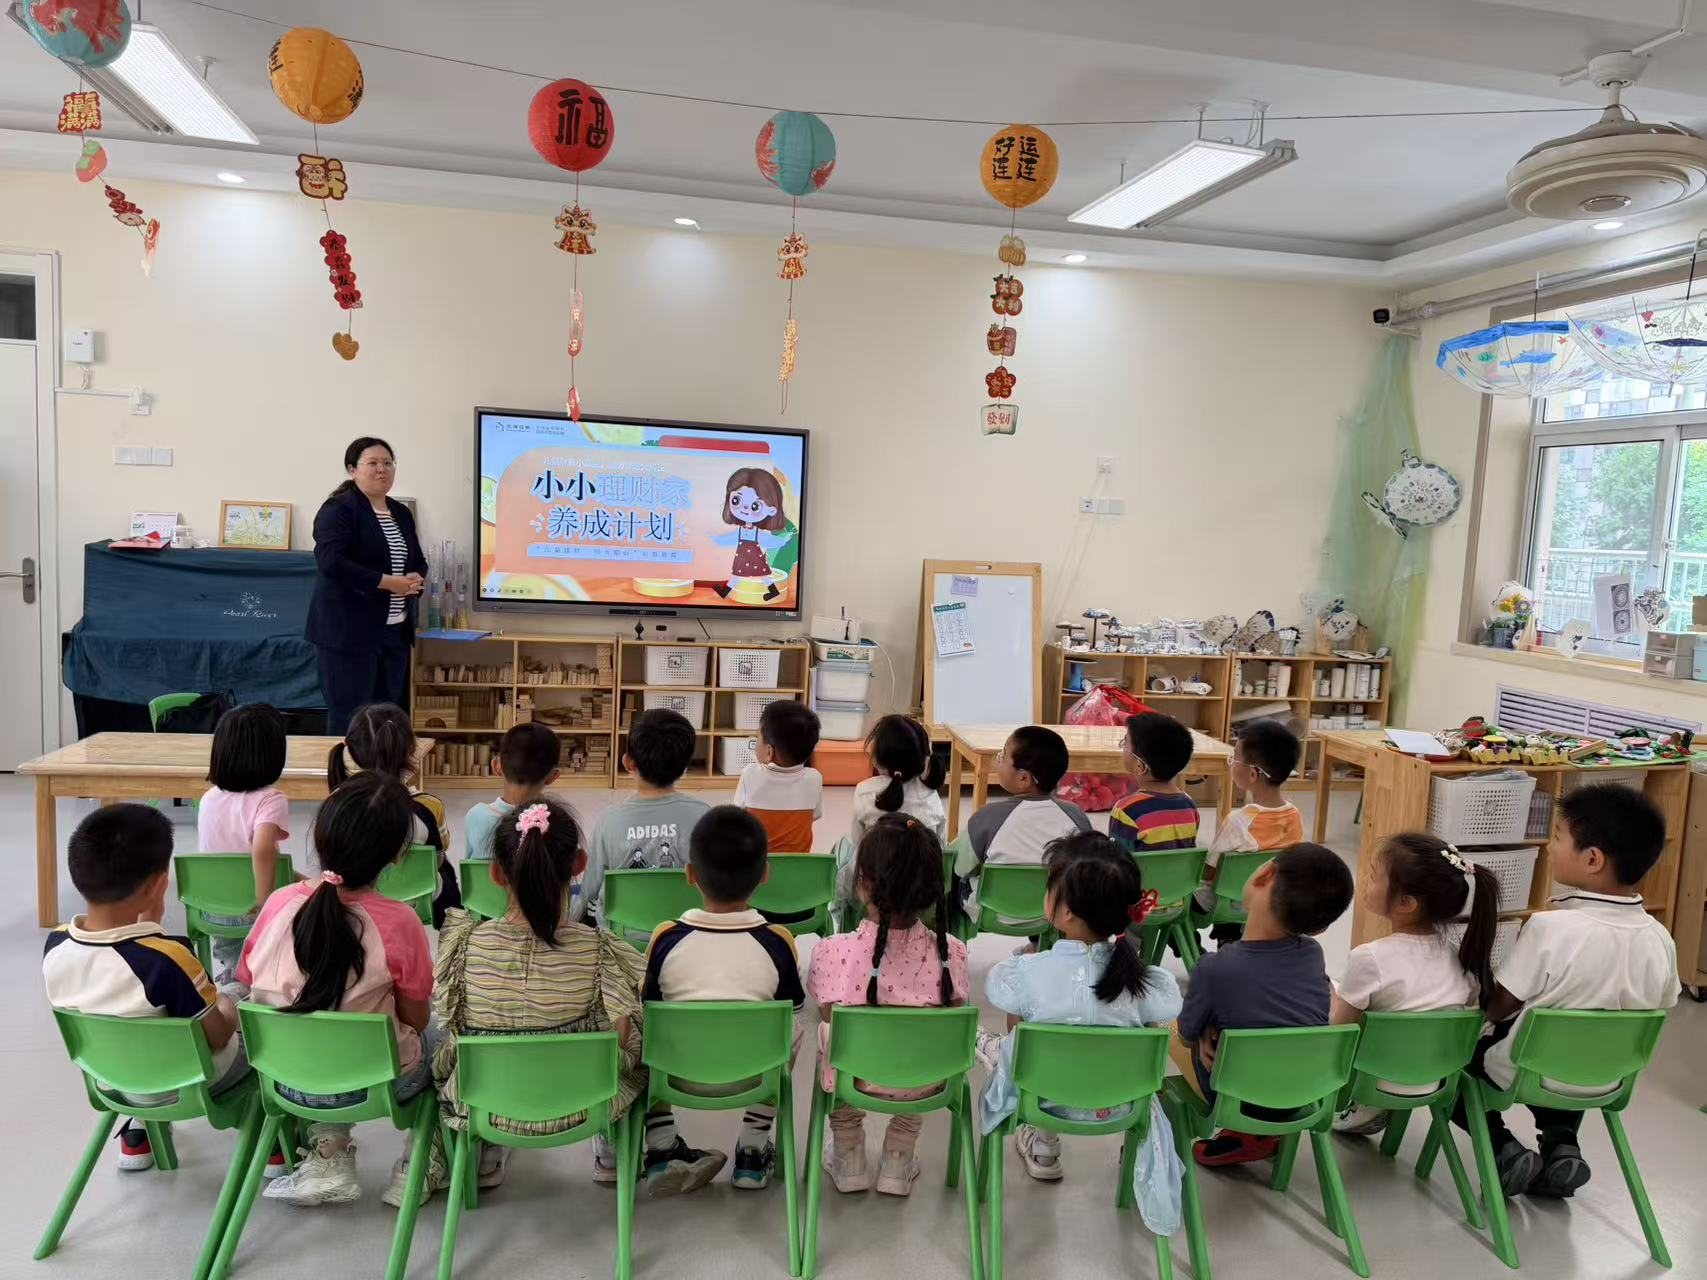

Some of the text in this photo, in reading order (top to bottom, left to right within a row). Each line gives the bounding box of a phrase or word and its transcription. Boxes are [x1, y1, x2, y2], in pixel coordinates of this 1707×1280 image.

[555, 89, 609, 149] 福
[995, 135, 1040, 159] 好运
[992, 157, 1037, 182] 连连
[998, 281, 1019, 294] 大吉
[532, 470, 689, 507] 小小理财家
[549, 506, 673, 542] 养成计划
[626, 823, 677, 840] ADIDAS
